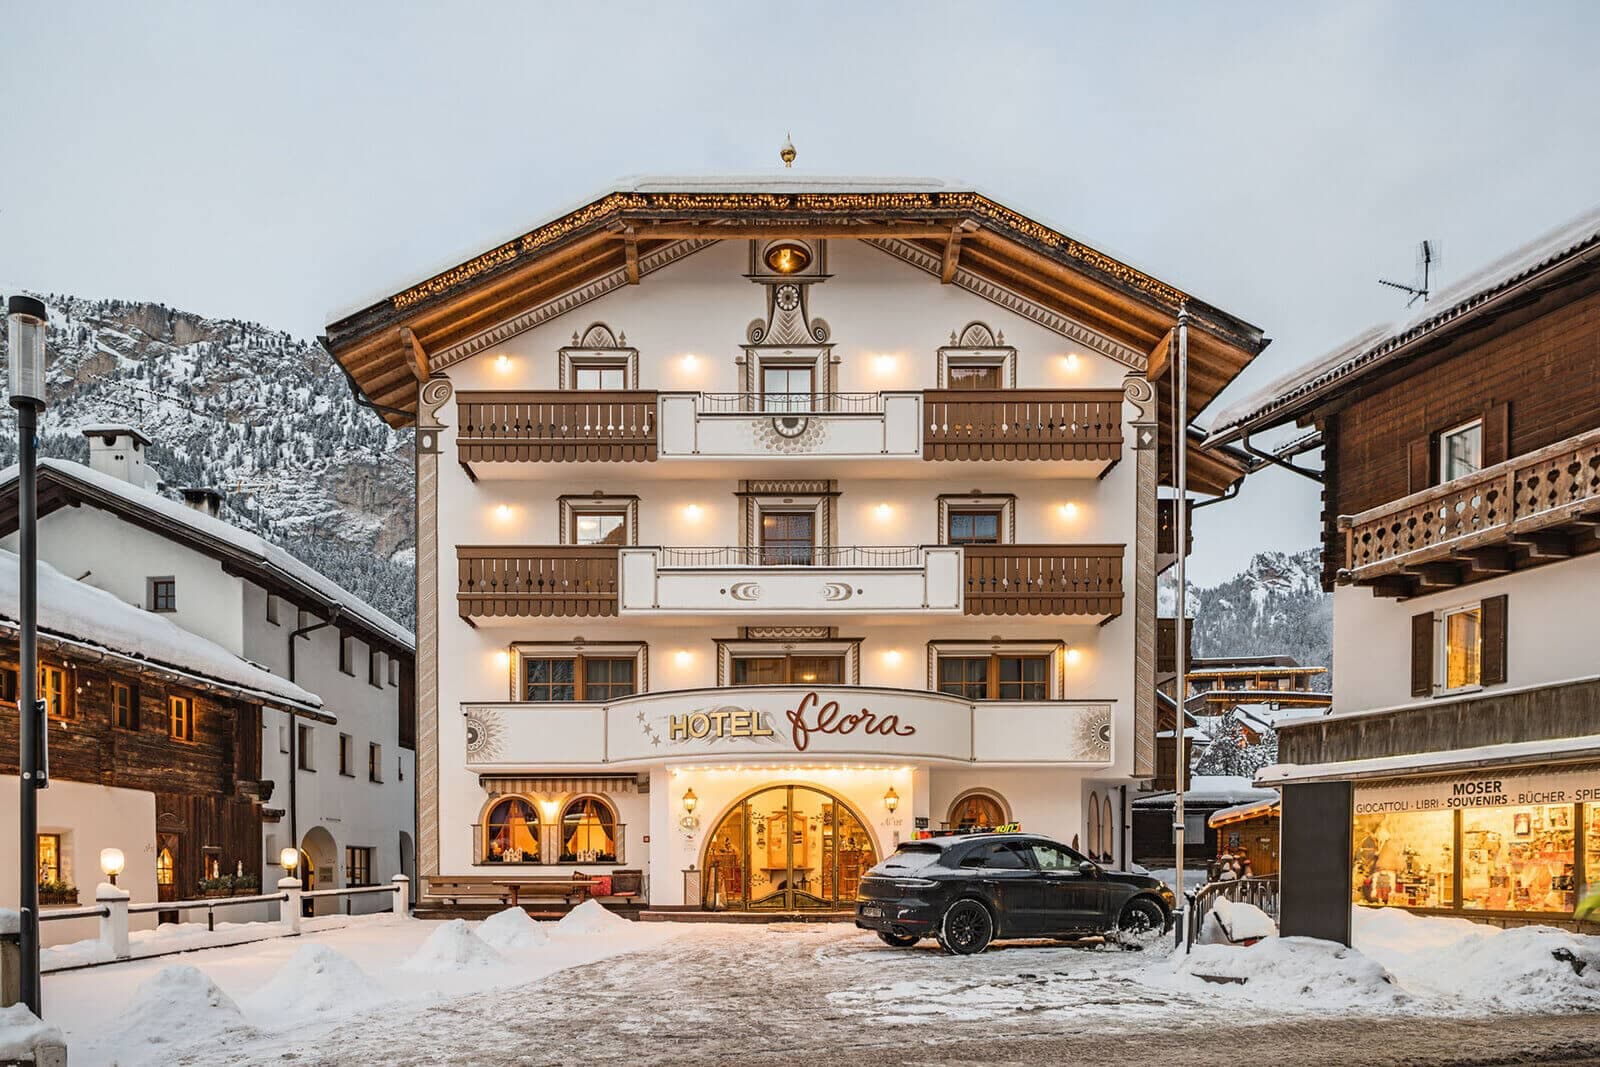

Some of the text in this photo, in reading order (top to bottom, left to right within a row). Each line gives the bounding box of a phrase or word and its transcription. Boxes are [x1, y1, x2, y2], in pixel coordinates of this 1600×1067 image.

[669, 711, 774, 740] HOTEL
[1356, 788, 1600, 813] GIOCATTOLI LIBRI SOUVENIRS BÜCHER SPIE
[1453, 780, 1502, 796] MOSER
